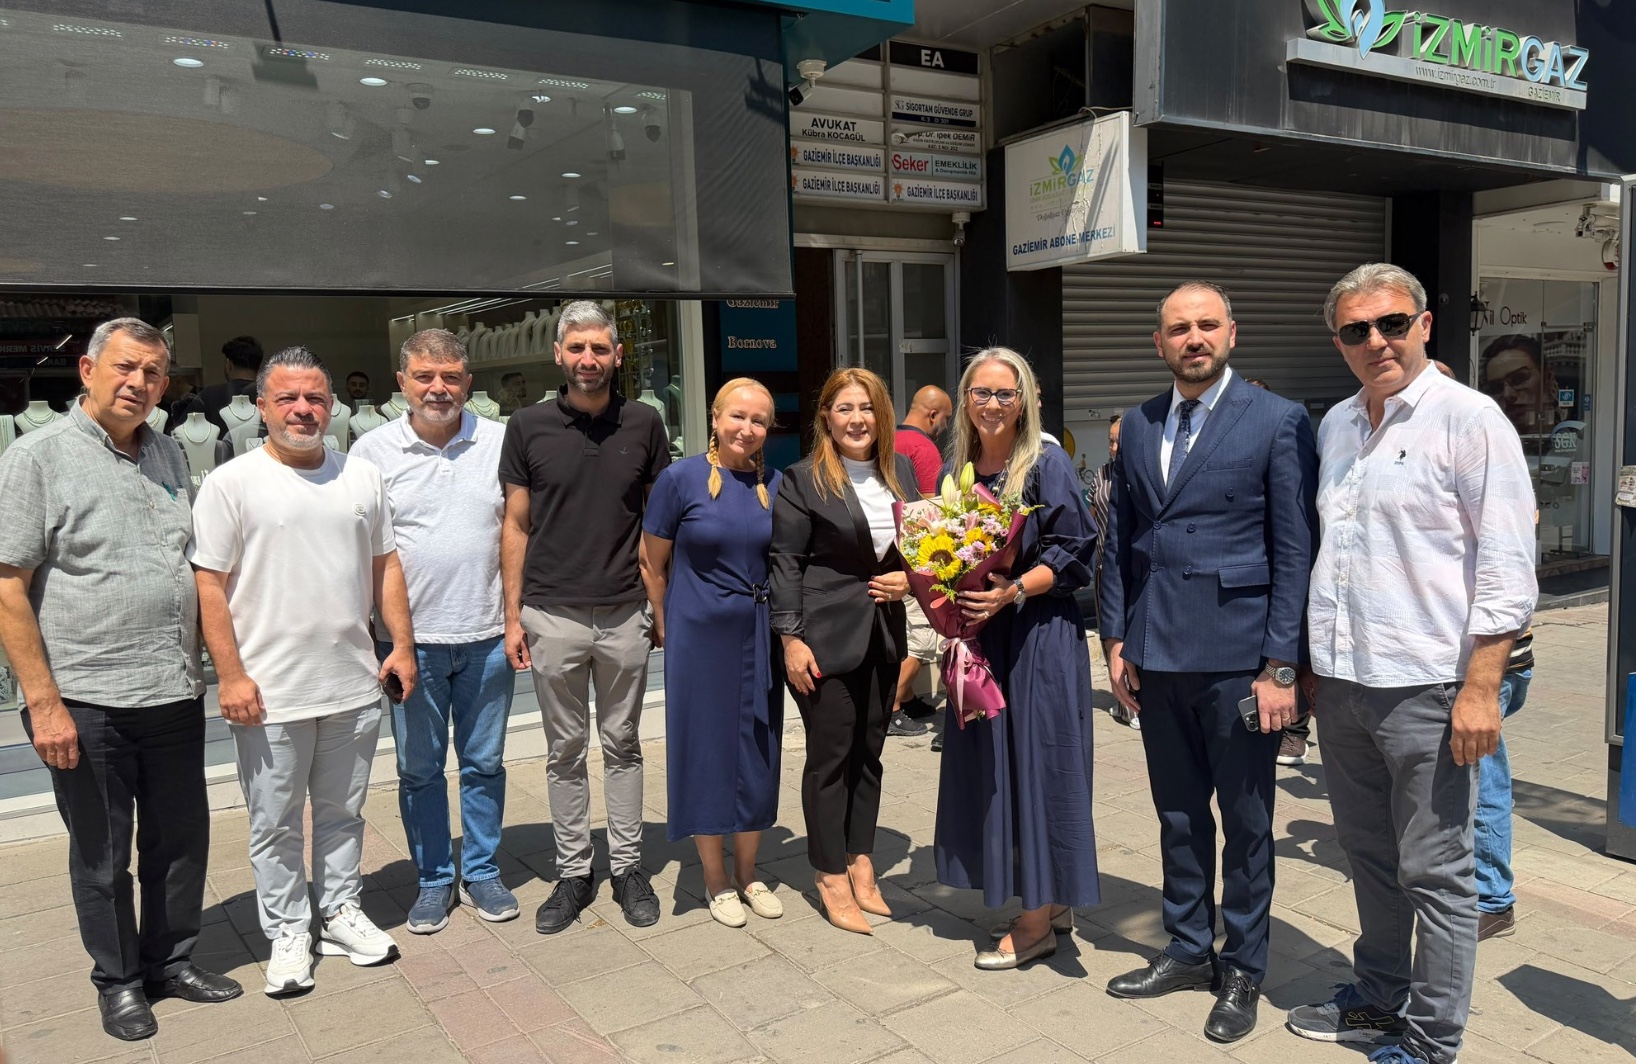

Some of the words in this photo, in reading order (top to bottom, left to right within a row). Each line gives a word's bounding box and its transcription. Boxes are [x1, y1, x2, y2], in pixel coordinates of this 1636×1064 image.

[920, 49, 945, 68] EA
[1415, 66, 1497, 89] www.izmirgaz.com.tr
[905, 100, 933, 114] SİGORTAM
[934, 104, 959, 117] GÜVENDE
[959, 109, 974, 118] GRUP
[811, 117, 857, 132] AVUKAT
[802, 129, 826, 137] Kübra
[827, 131, 866, 142] KOCAGÜL
[803, 147, 832, 163] GAZİEMİR
[832, 149, 846, 166] İLÇE
[846, 153, 881, 168] BAŞKANLIĞI
[892, 153, 929, 172] Şeker
[935, 160, 978, 170] EMEKLİLİK
[802, 176, 831, 192] GAZİEMİR
[831, 177, 845, 193] İLÇE
[846, 181, 881, 195] BAŞKANLIĞI
[907, 184, 933, 198] GAZİEMİR
[933, 185, 945, 200] İLÇE
[946, 188, 978, 202] BAŞKANLIĞI
[1012, 237, 1048, 256] GAZİEMİR
[1049, 232, 1077, 249] ABONE
[1500, 306, 1527, 328] Optik
[727, 336, 777, 349] Bornova
[1554, 432, 1578, 449] SGK
